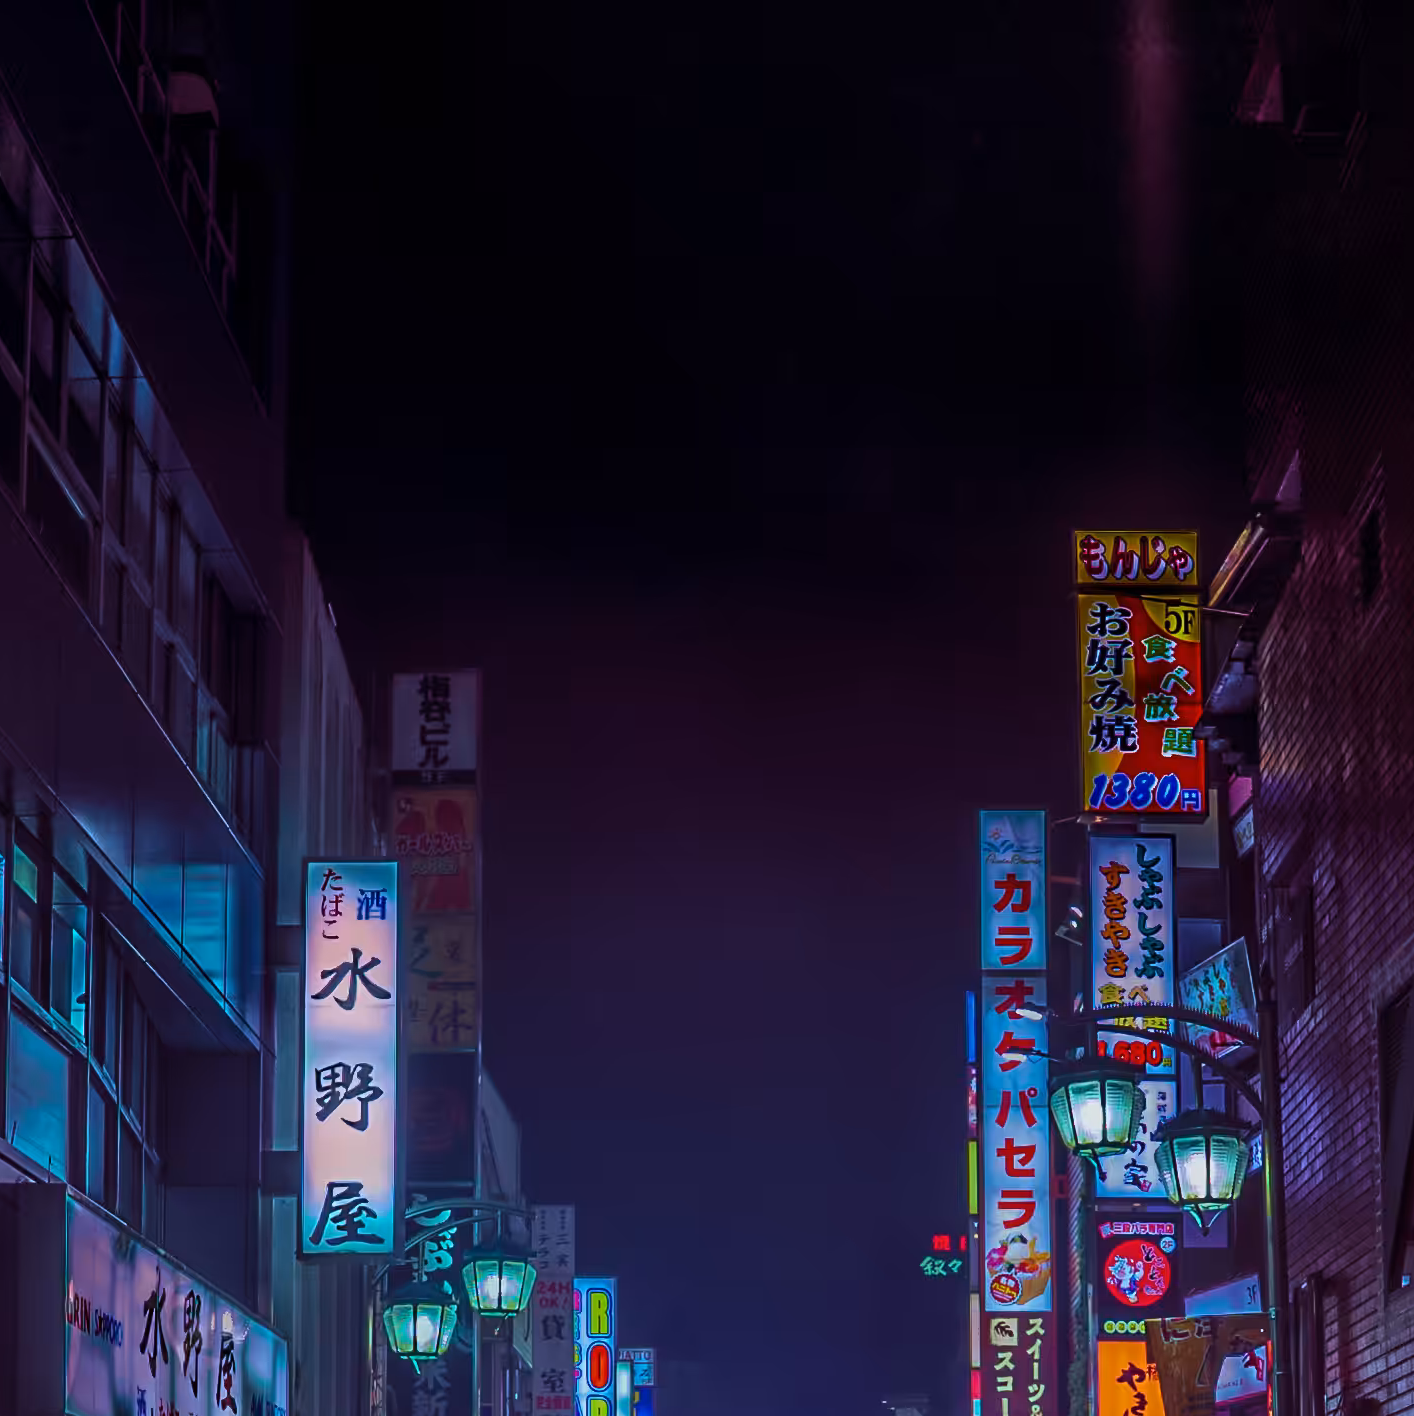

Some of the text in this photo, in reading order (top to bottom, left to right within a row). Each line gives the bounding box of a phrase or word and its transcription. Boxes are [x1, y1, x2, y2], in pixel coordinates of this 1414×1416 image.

[1079, 534, 1195, 581] もんじゃ
[1164, 608, 1197, 635] 5F
[1085, 602, 1139, 753] お好み焼
[1141, 634, 1198, 757] 食べ放題
[1089, 772, 1202, 811] 1380円
[320, 868, 344, 941] たばこ
[357, 888, 388, 921] 酒
[1099, 861, 1131, 978] すきやき
[1133, 844, 1165, 980] しゃぶしゃぶ
[308, 946, 393, 1248] 水野屋
[992, 873, 1037, 1229] カラオケパセラ
[537, 1281, 572, 1295] 24H
[1162, 1239, 1174, 1249] 2F
[139, 1264, 238, 1416] 水野屋
